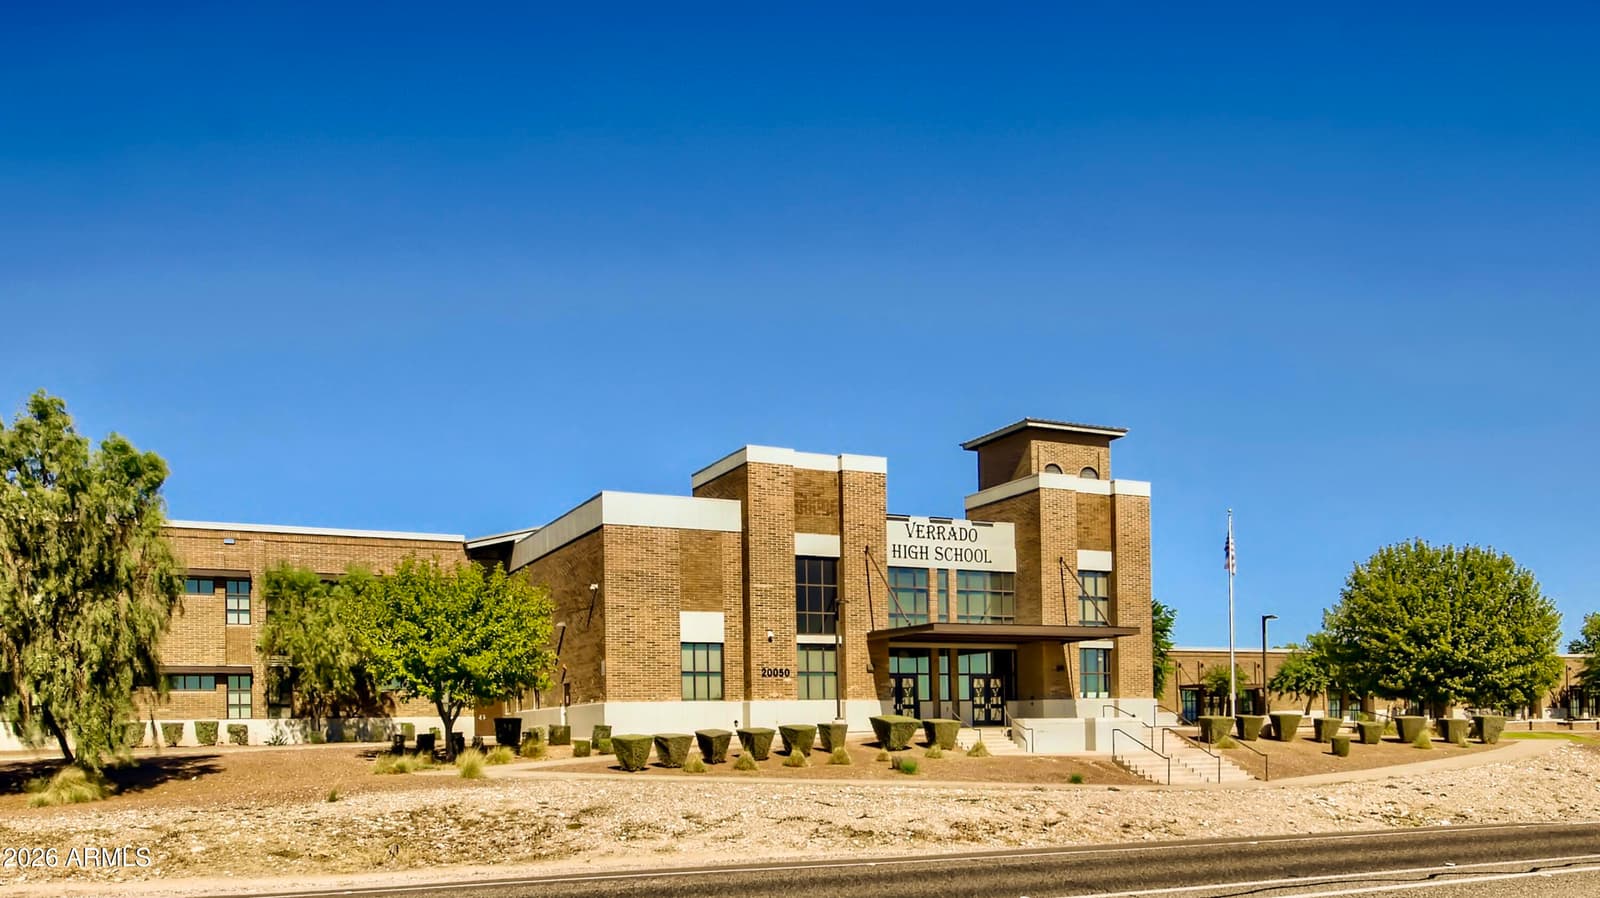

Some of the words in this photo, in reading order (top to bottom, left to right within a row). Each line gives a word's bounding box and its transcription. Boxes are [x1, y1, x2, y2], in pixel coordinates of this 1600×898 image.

[905, 522, 978, 542] VERRADO
[892, 544, 929, 560] HIGH
[934, 546, 992, 563] SCHOOL
[761, 667, 790, 677] 20050
